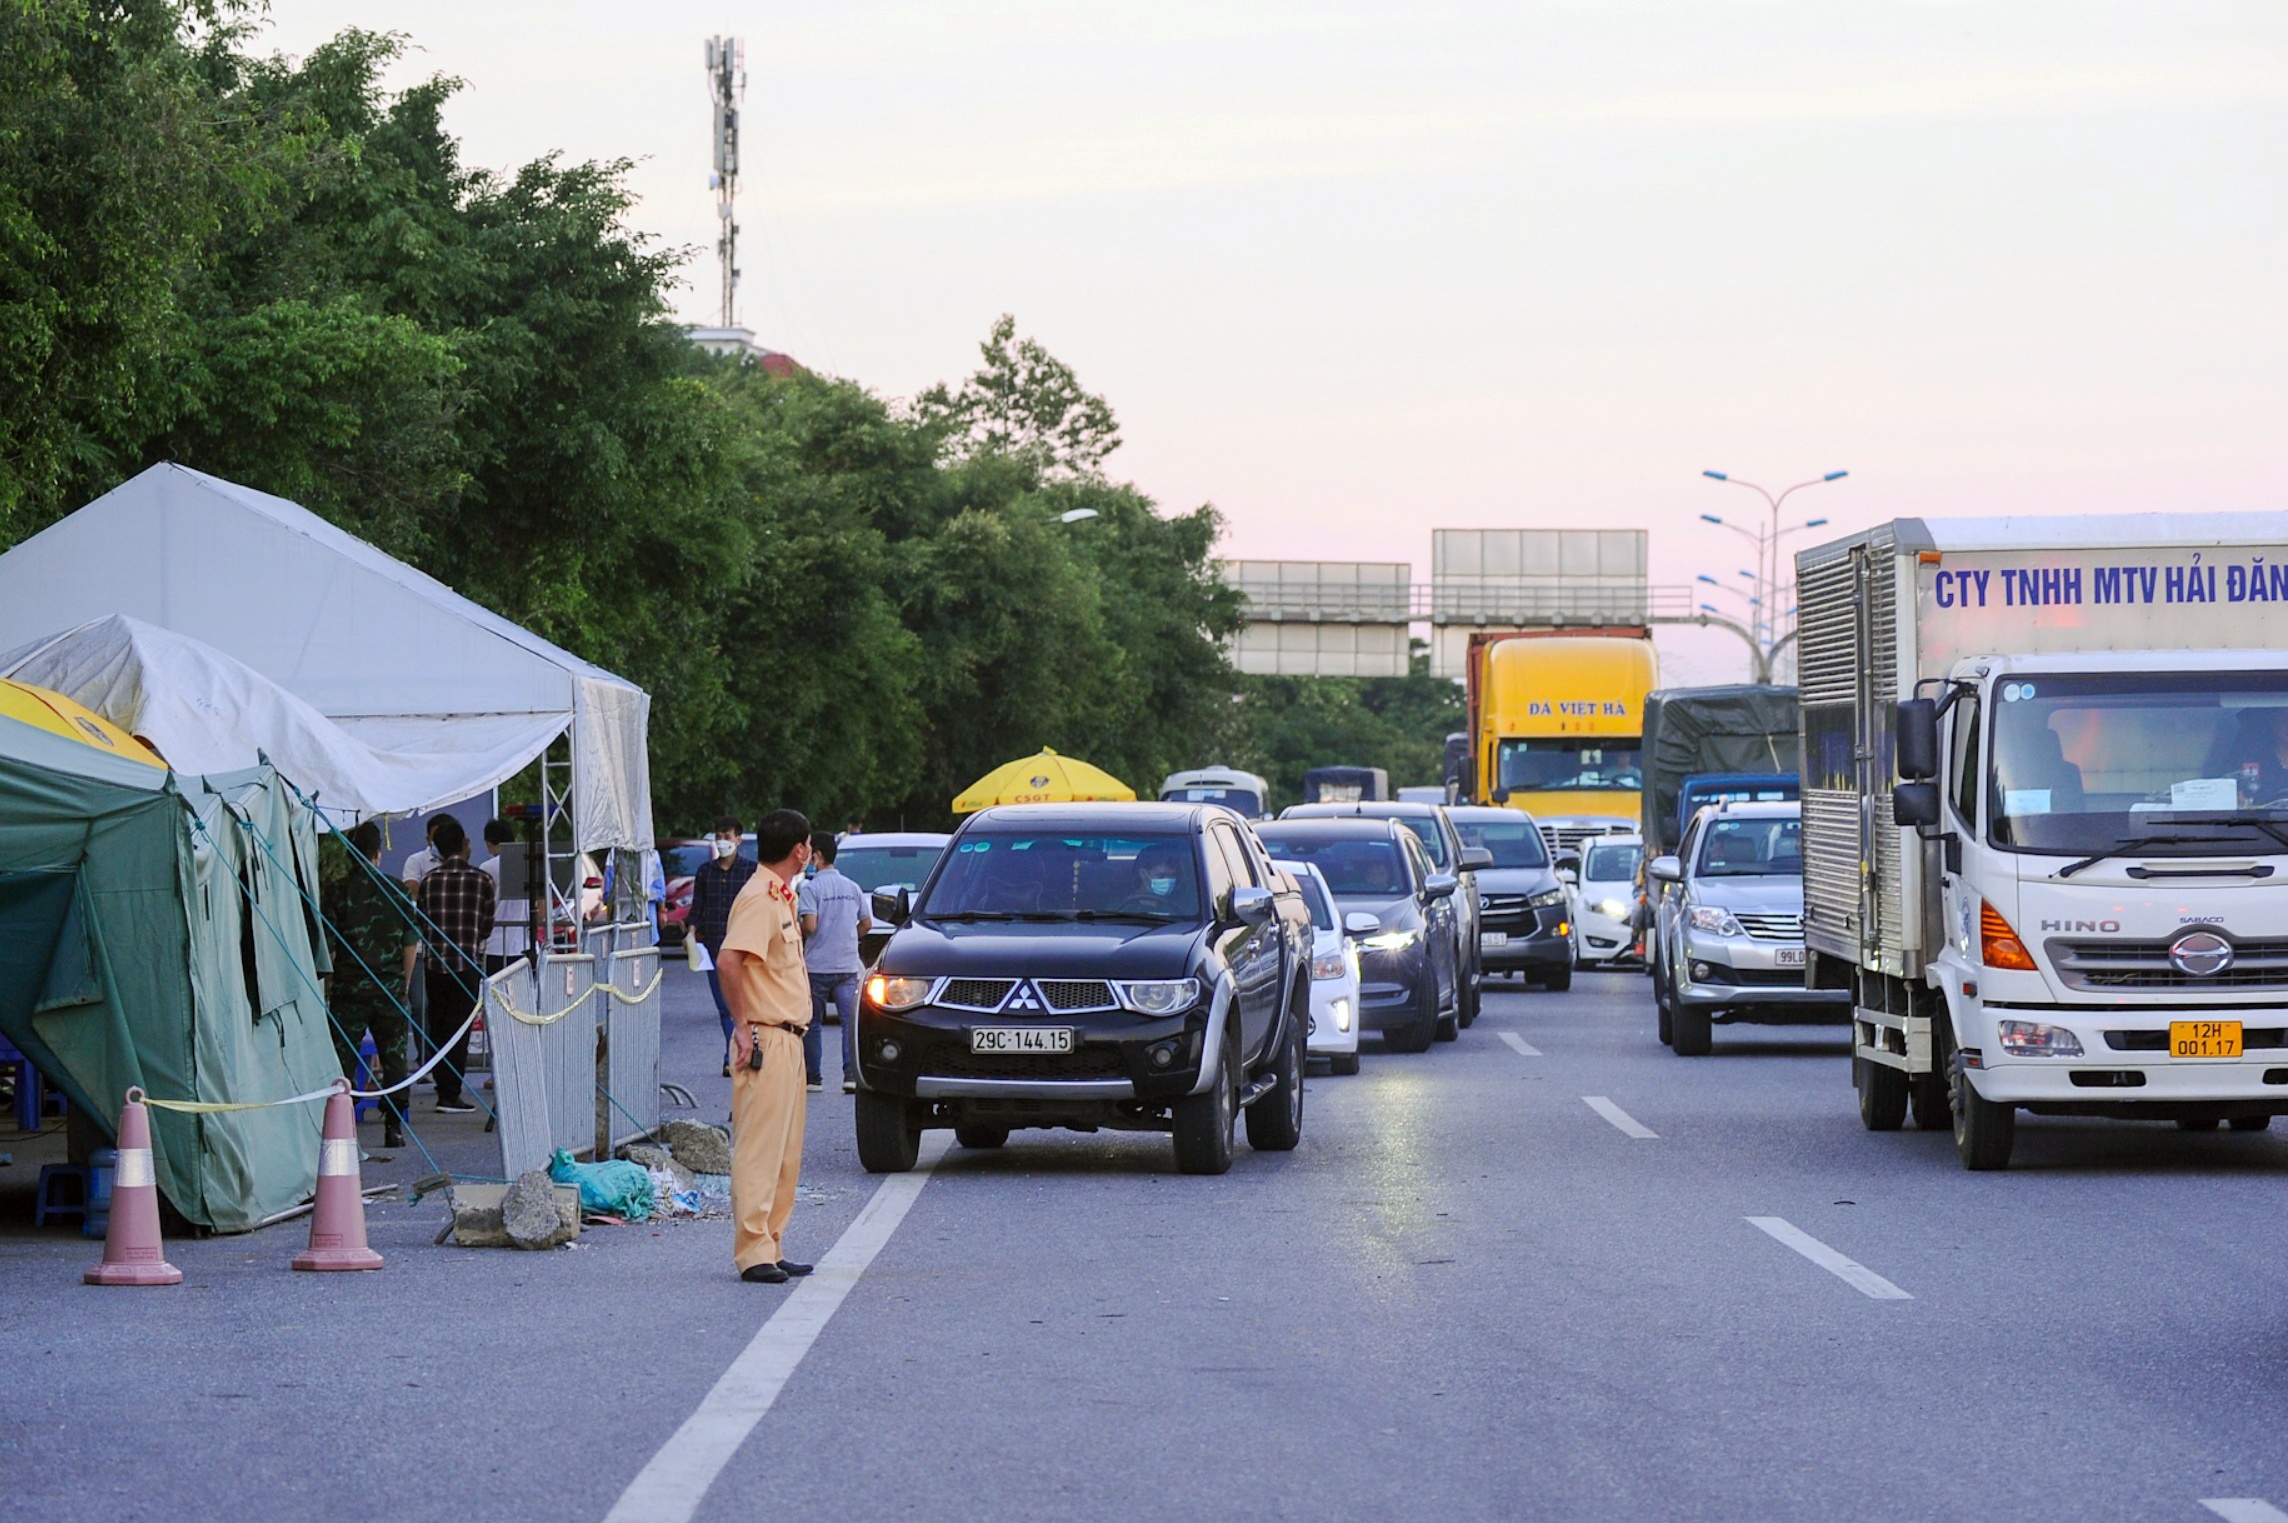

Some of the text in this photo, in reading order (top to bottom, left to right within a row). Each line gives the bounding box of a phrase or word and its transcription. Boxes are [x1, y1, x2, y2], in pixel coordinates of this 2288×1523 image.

[1935, 569, 1991, 609] CTY
[2001, 567, 2083, 606] TNHH
[2094, 566, 2158, 604] MTV
[2165, 552, 2217, 603] HẢI
[1014, 794, 1050, 803] CSGT
[2041, 920, 2121, 933] HINO
[2179, 916, 2225, 924] SABACO
[2192, 1023, 2222, 1039] 12H
[975, 1030, 1069, 1050] 29C-144.15
[2178, 1040, 2235, 1055] 001.17
